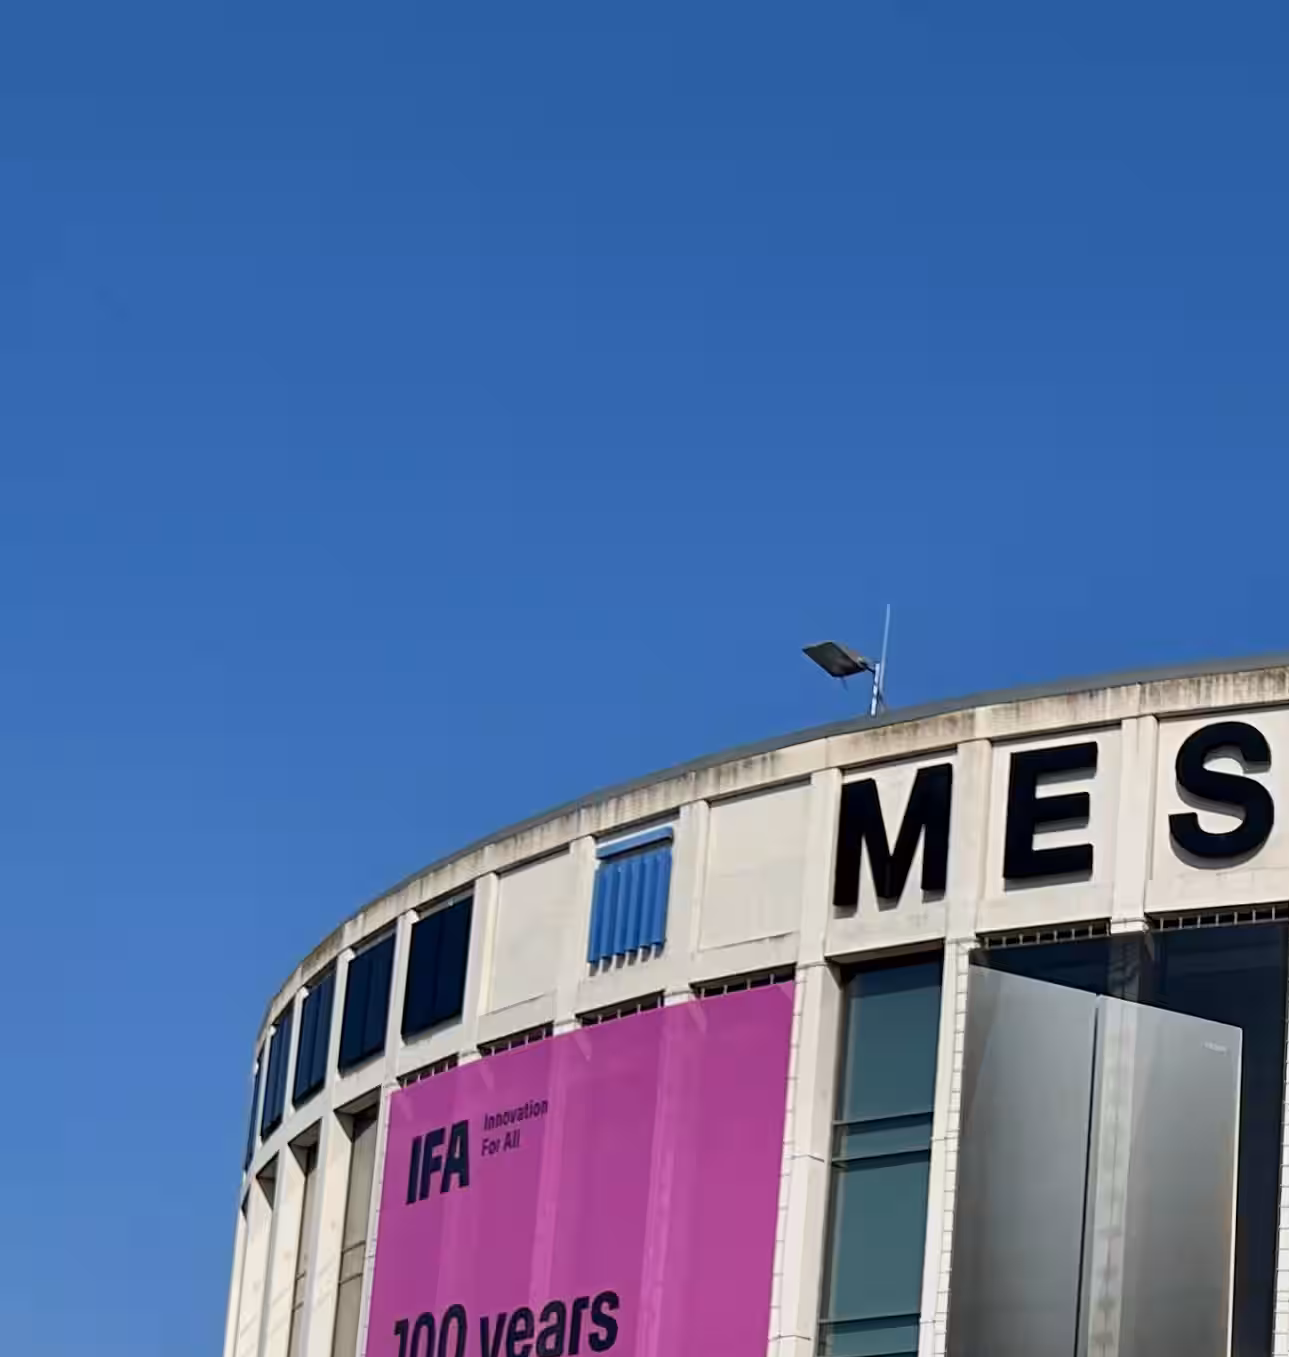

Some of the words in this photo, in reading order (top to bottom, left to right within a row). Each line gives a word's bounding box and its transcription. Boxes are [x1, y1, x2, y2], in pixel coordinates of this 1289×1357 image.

[484, 1099, 549, 1131] Innovation
[481, 1138, 500, 1157] For
[503, 1128, 521, 1152] All
[405, 1119, 470, 1205] IFA
